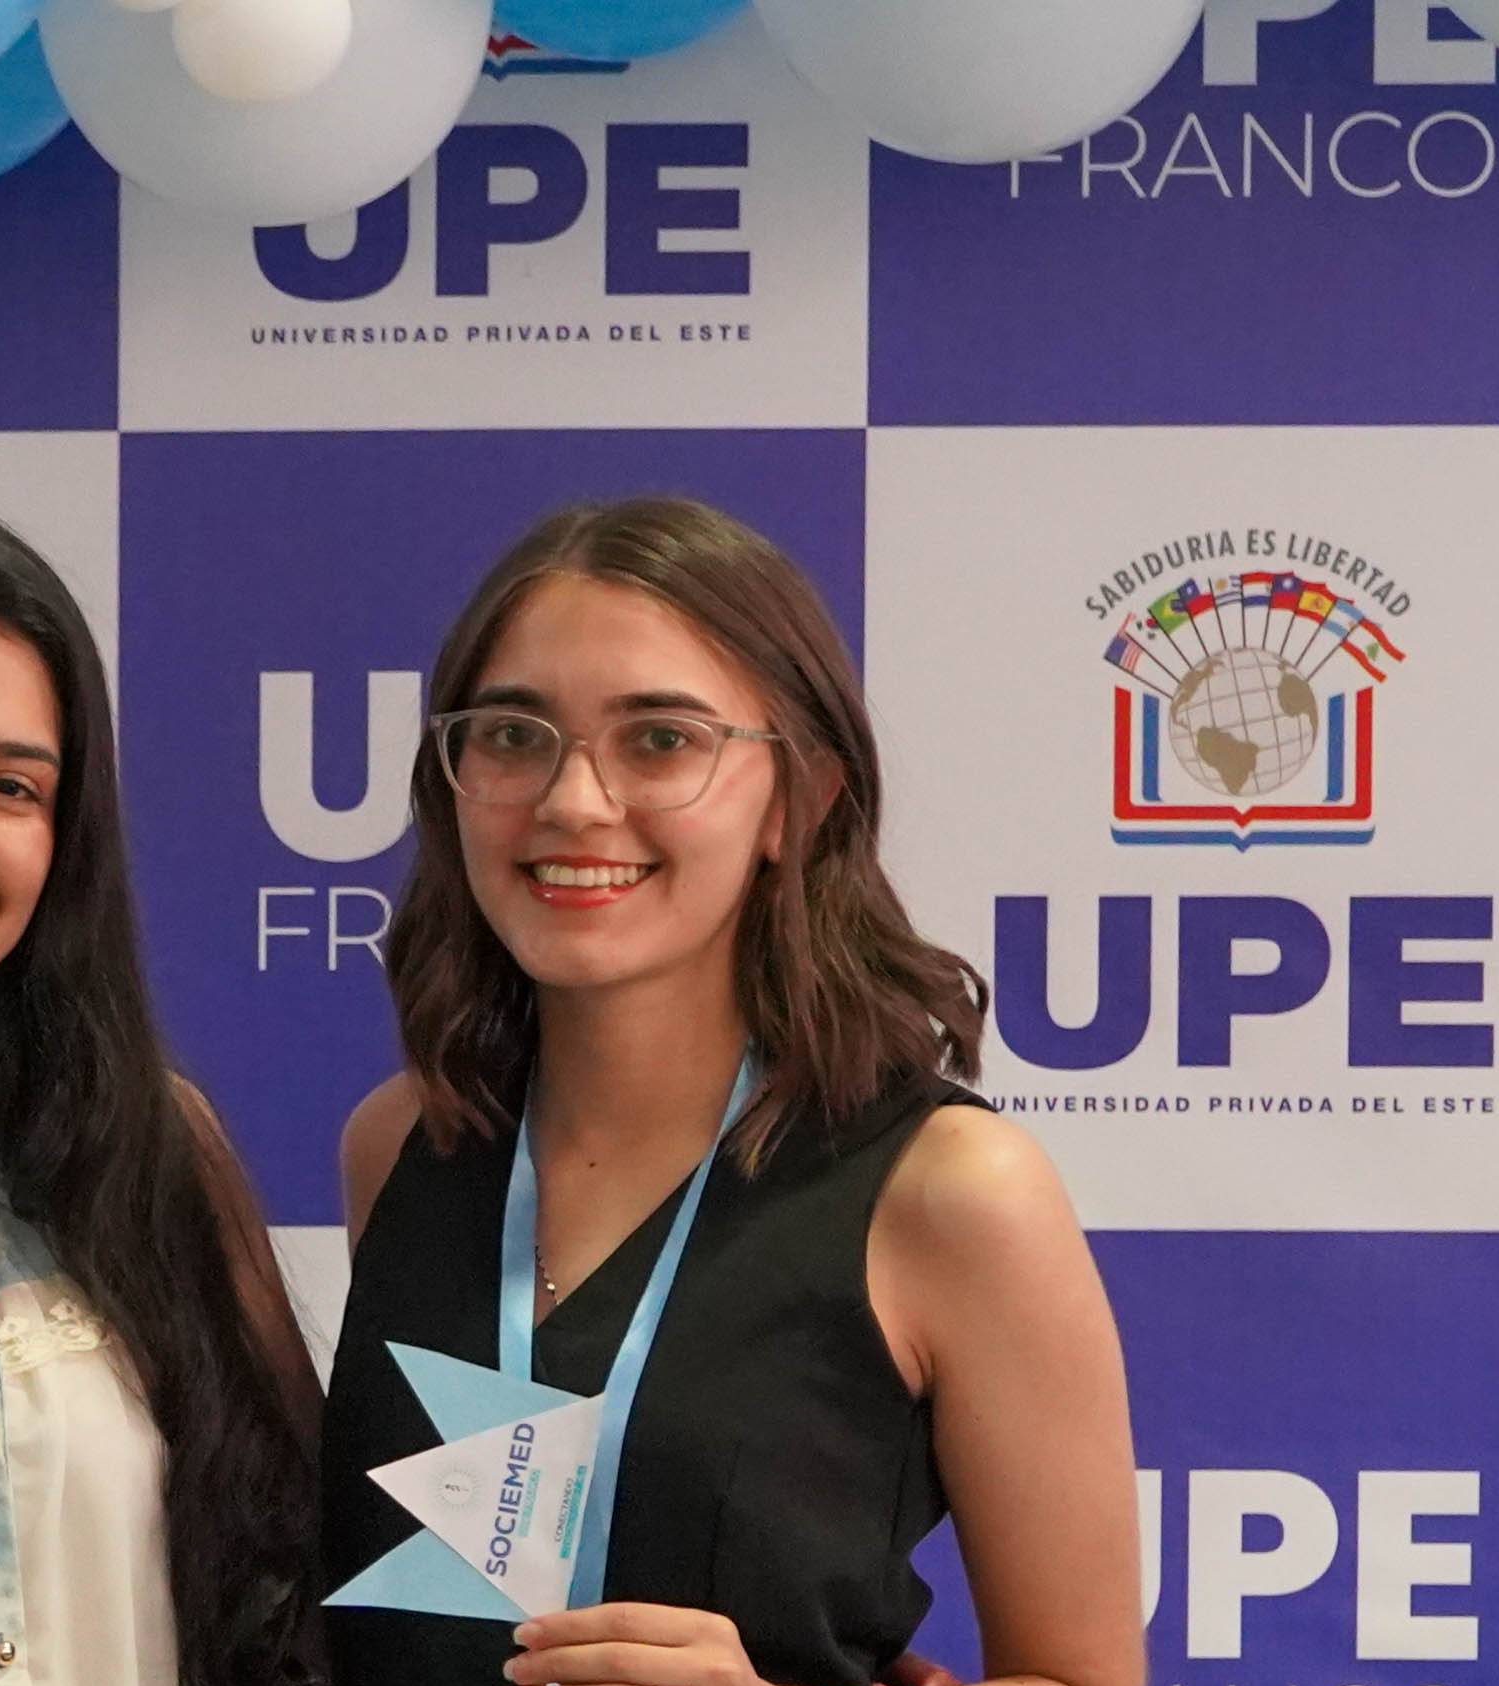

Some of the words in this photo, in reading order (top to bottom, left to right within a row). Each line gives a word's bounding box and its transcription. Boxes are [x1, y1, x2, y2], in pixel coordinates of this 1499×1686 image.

[251, 327, 449, 345] UNIVERSIDAD
[466, 326, 591, 342] PRIVADA
[610, 326, 661, 342] DEL
[680, 325, 751, 341] ESTE
[1085, 532, 1236, 621] SABIDURIA
[1247, 529, 1278, 557] ES
[1286, 531, 1413, 619] LIBERTAD
[993, 895, 1495, 1071] UPE
[992, 1096, 1191, 1113] UNIVERSIDAD
[1208, 1096, 1334, 1113] PRIVADA
[1352, 1096, 1405, 1112] DEL
[1424, 1097, 1495, 1113] ESTE
[485, 1423, 535, 1577] SOCIEMED
